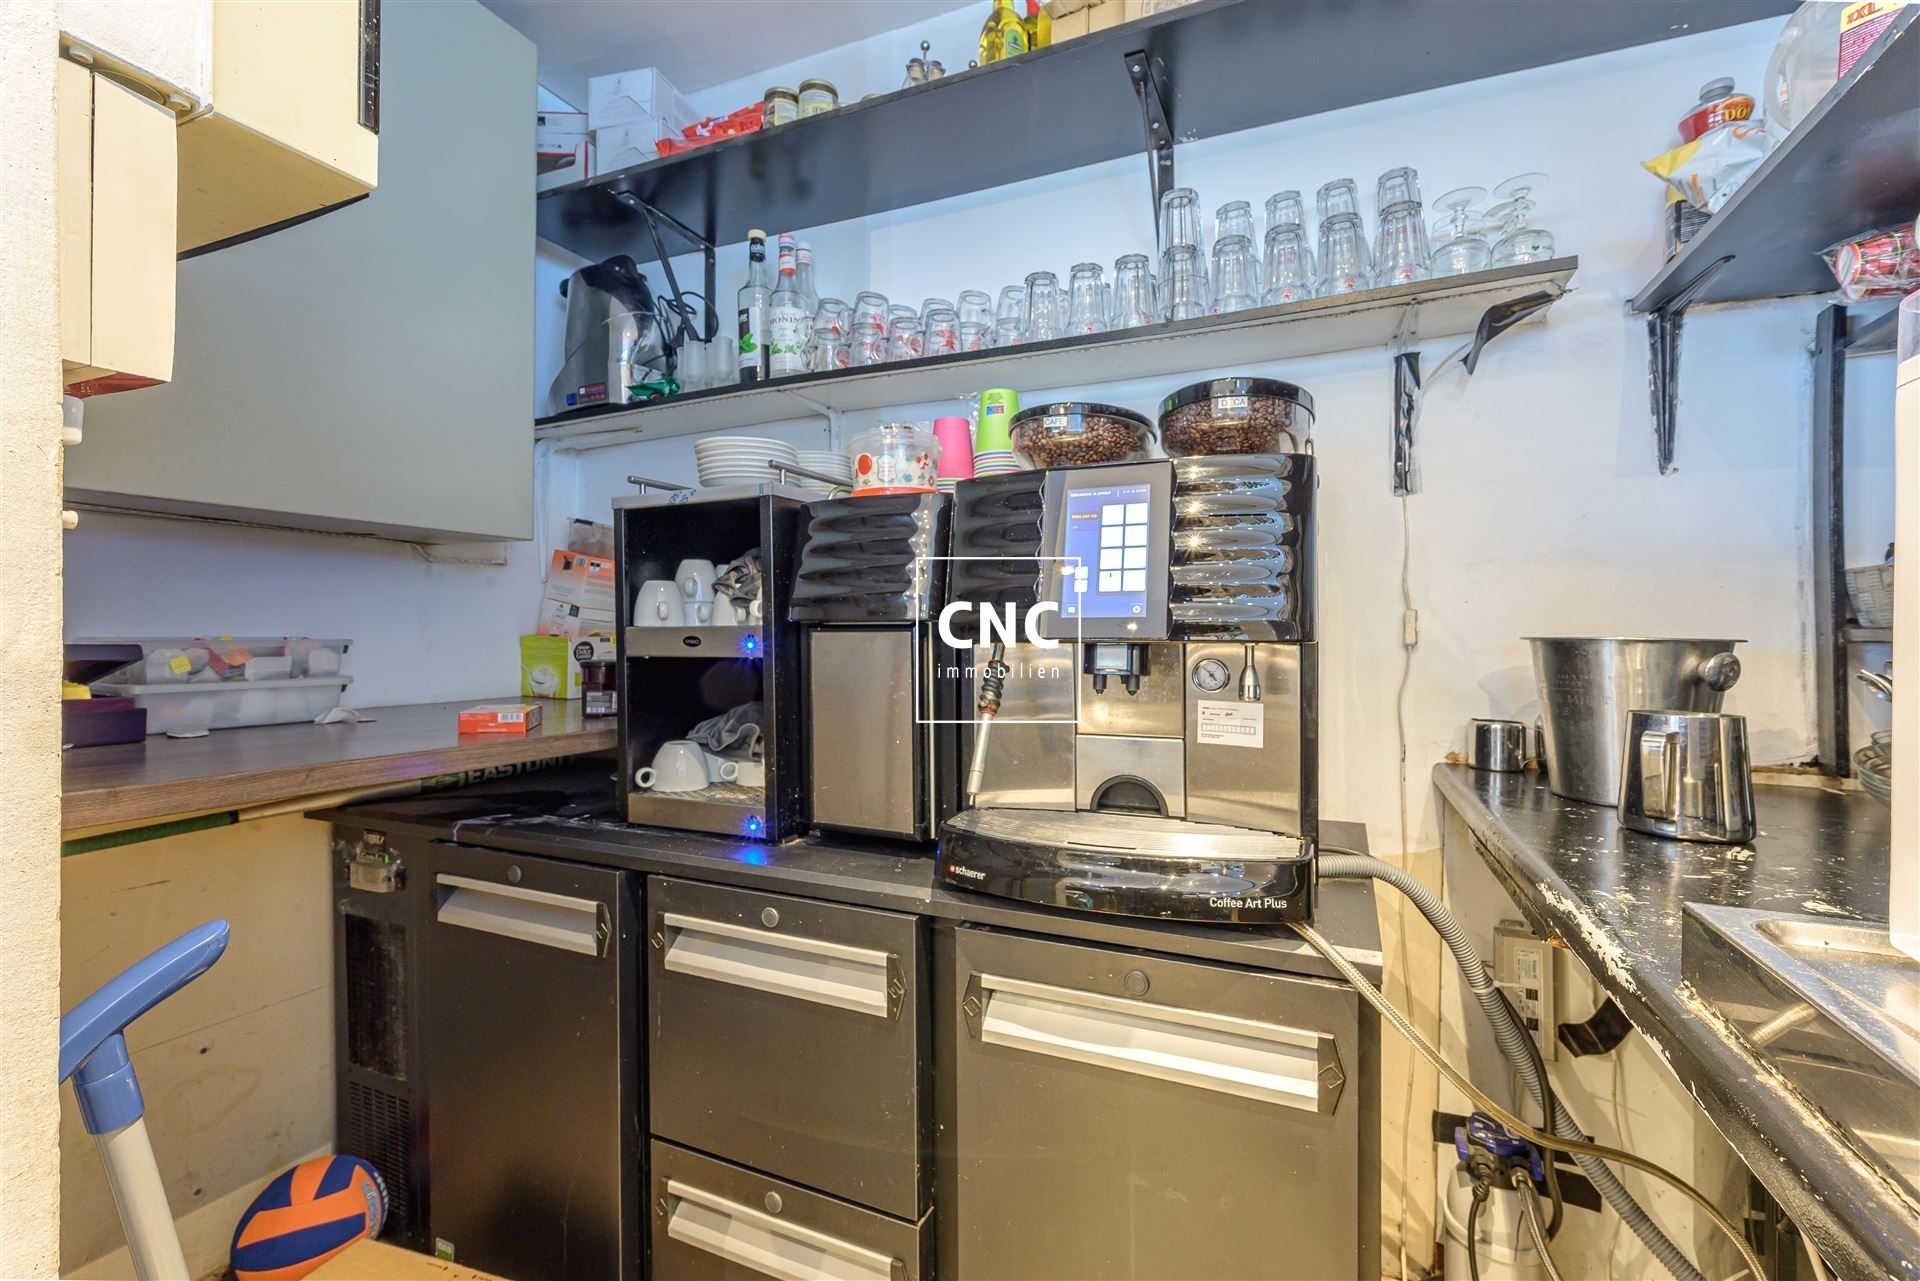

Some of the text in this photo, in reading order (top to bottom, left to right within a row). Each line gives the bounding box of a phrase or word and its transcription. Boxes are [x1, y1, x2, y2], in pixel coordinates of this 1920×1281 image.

[1846, 2, 1883, 24] XXL
[955, 866, 987, 880] schaerer
[1209, 897, 1288, 909] Coffee Art Plus
